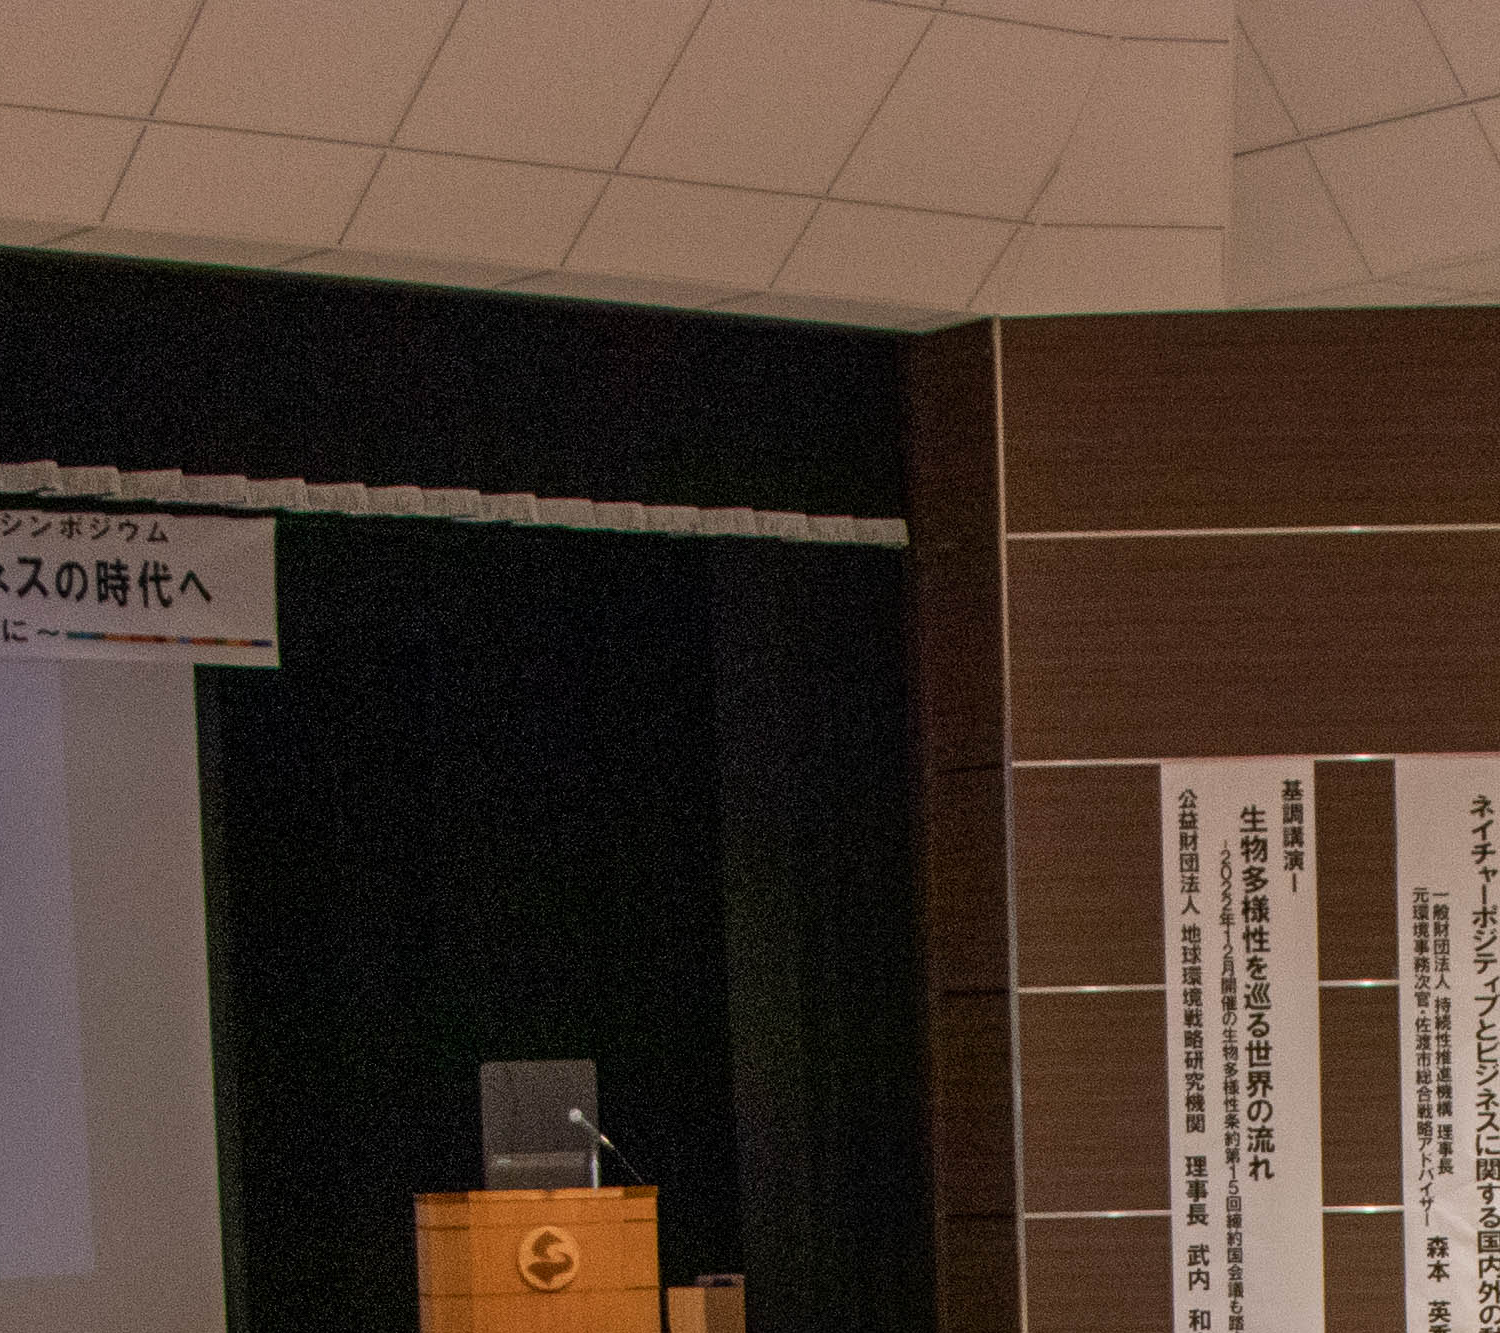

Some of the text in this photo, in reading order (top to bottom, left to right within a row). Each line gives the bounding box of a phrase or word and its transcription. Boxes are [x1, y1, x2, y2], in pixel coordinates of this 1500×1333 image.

[1239, 803, 1276, 1182] 生物多様性を巡る世界の流れ
[1436, 1123, 1455, 1176] 理事長
[1184, 1154, 1210, 1228] 理事長
